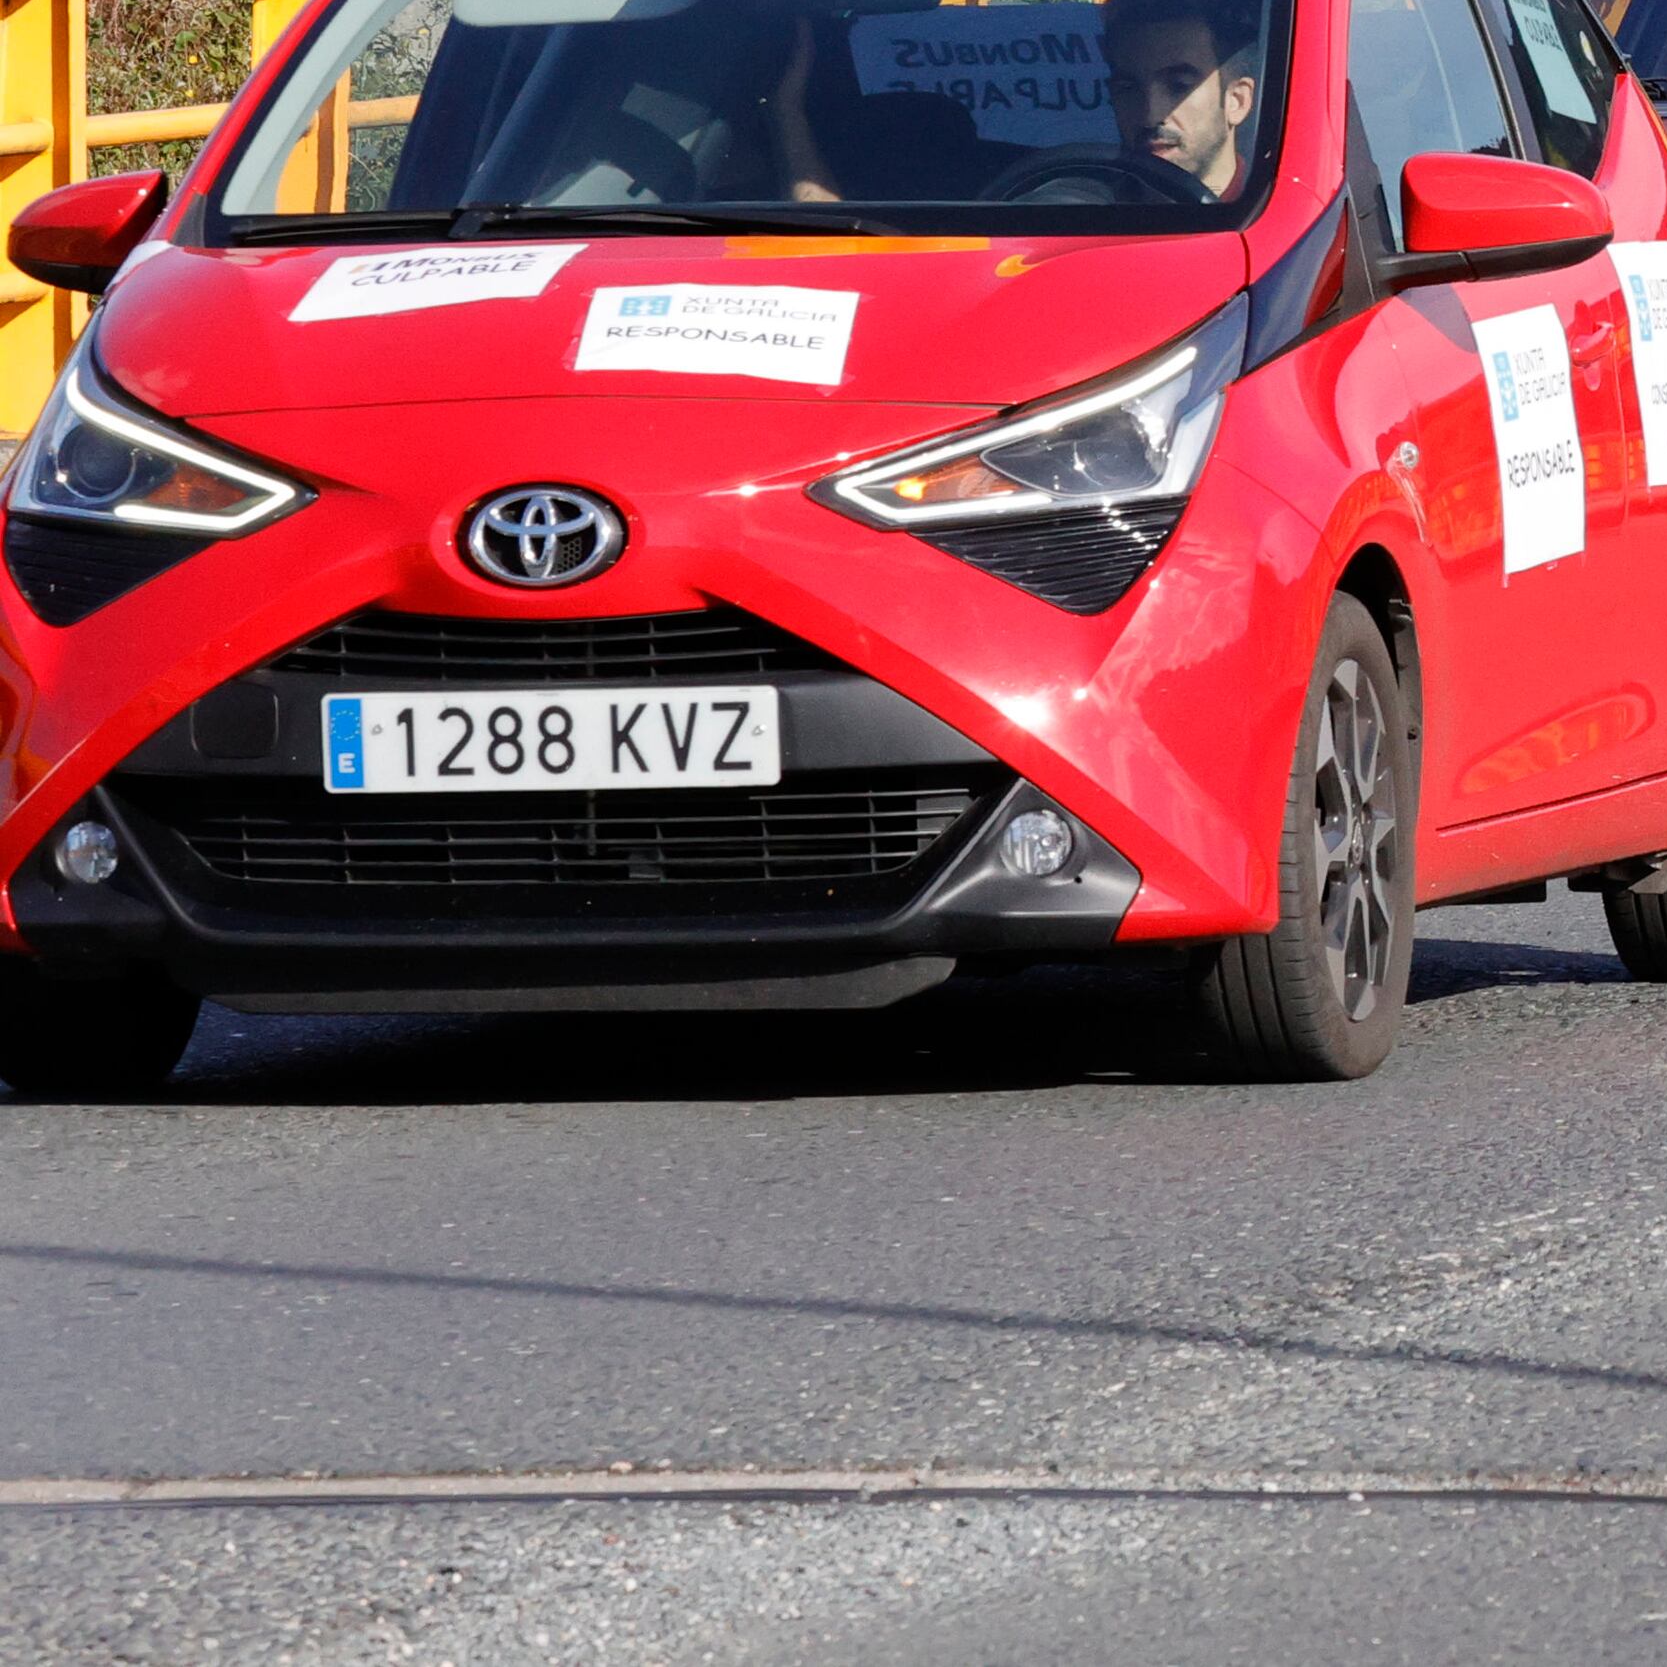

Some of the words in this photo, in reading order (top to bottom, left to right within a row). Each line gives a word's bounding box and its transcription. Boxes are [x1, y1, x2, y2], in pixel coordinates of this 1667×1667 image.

[351, 260, 537, 287] CULPABLE
[682, 305, 715, 314] DE
[724, 306, 838, 323] GALICIA
[686, 296, 779, 308] XUNTA
[606, 325, 825, 350] RESPONSABLE
[1514, 347, 1546, 375] XUNTA
[1518, 381, 1532, 406] DE
[1506, 439, 1576, 488] RESPONSABLE
[396, 705, 576, 777] 1288
[609, 701, 753, 774] KVZ
[338, 753, 356, 774] E
